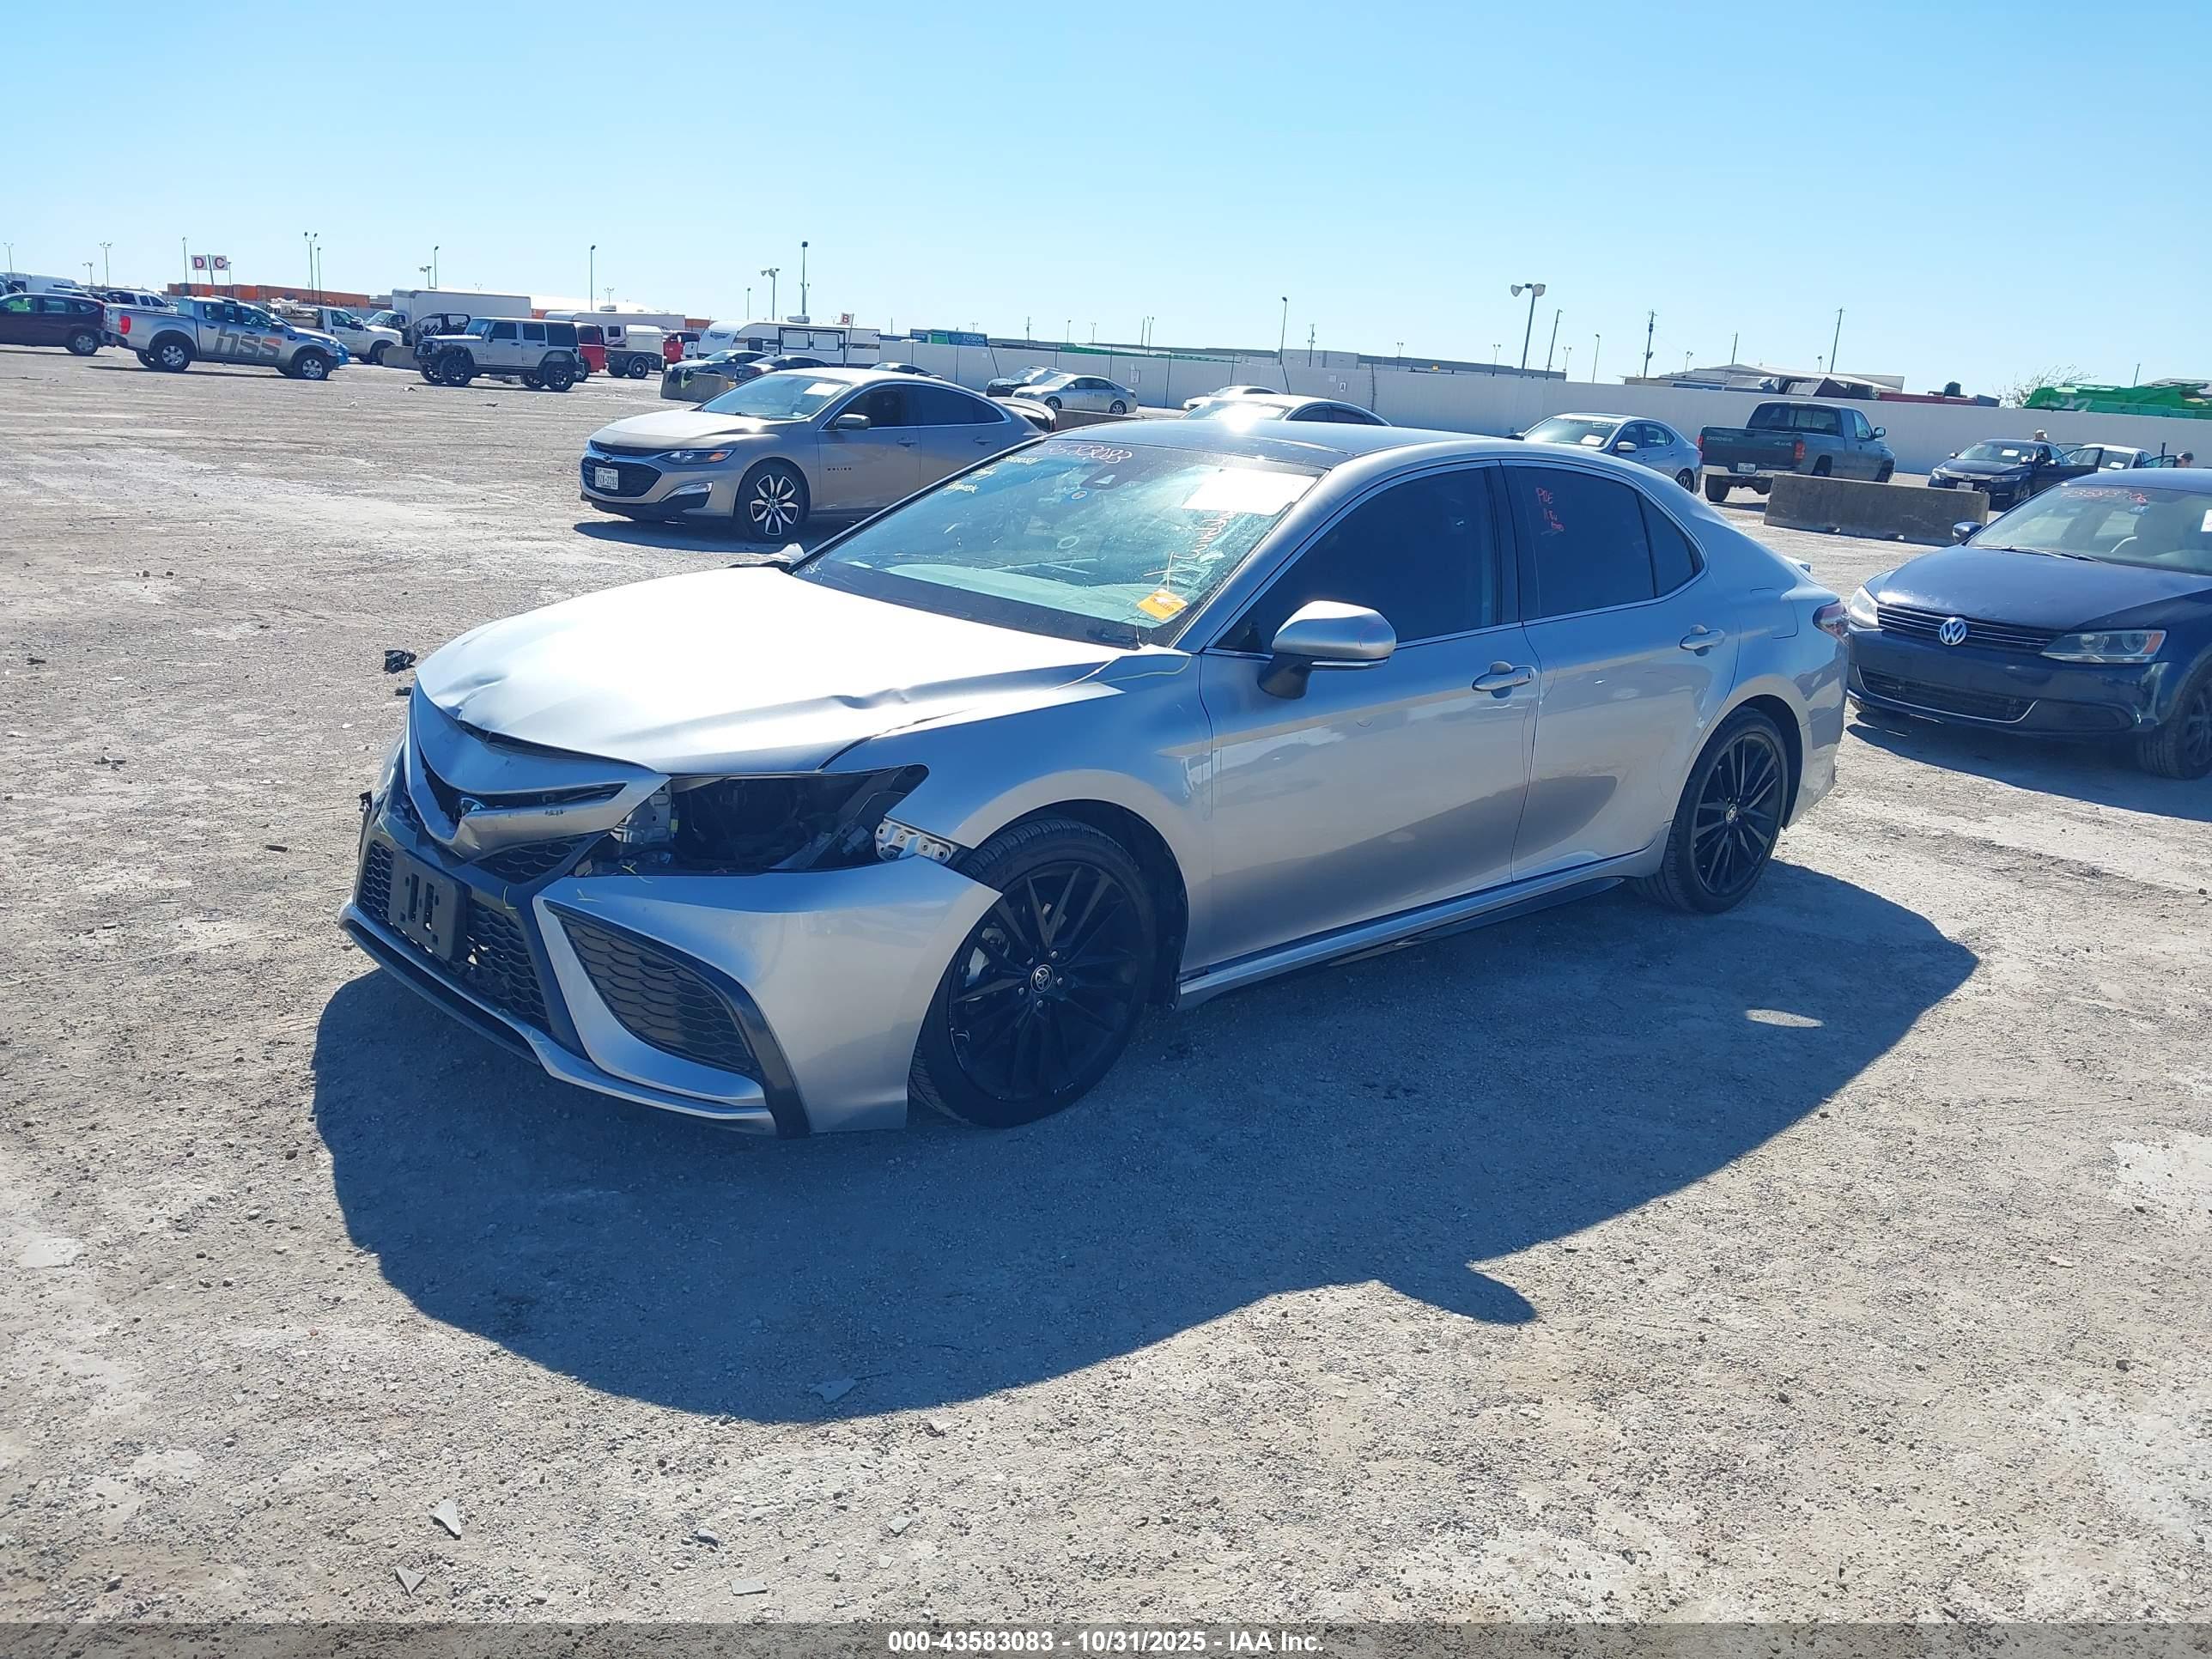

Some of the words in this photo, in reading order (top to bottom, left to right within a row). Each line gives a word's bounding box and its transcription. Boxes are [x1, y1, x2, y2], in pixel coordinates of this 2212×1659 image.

[193, 257, 204, 269] D
[215, 257, 225, 269] C
[842, 313, 850, 324] B
[214, 324, 283, 358] hss
[963, 334, 985, 343] FUSION
[1340, 382, 1346, 392] A
